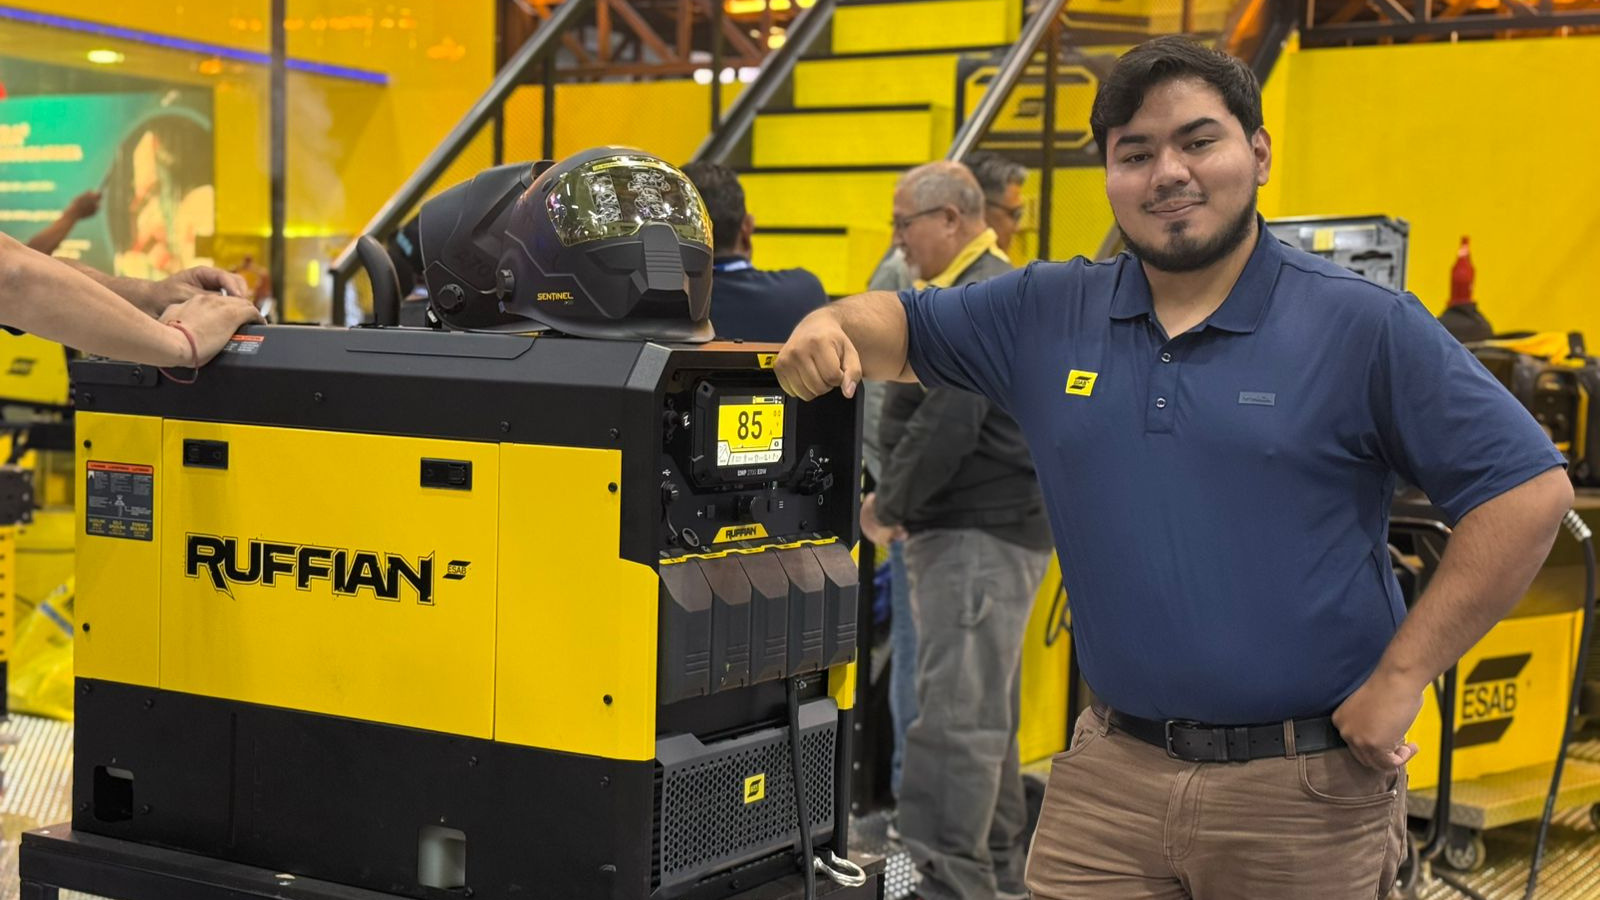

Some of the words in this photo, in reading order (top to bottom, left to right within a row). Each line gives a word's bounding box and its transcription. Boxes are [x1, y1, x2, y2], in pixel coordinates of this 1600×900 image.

[537, 291, 574, 301] SENTINEL
[737, 410, 763, 440] 85
[185, 532, 436, 606] RUFFIAN
[447, 565, 467, 575] ESAB
[1462, 683, 1517, 719] ESAB
